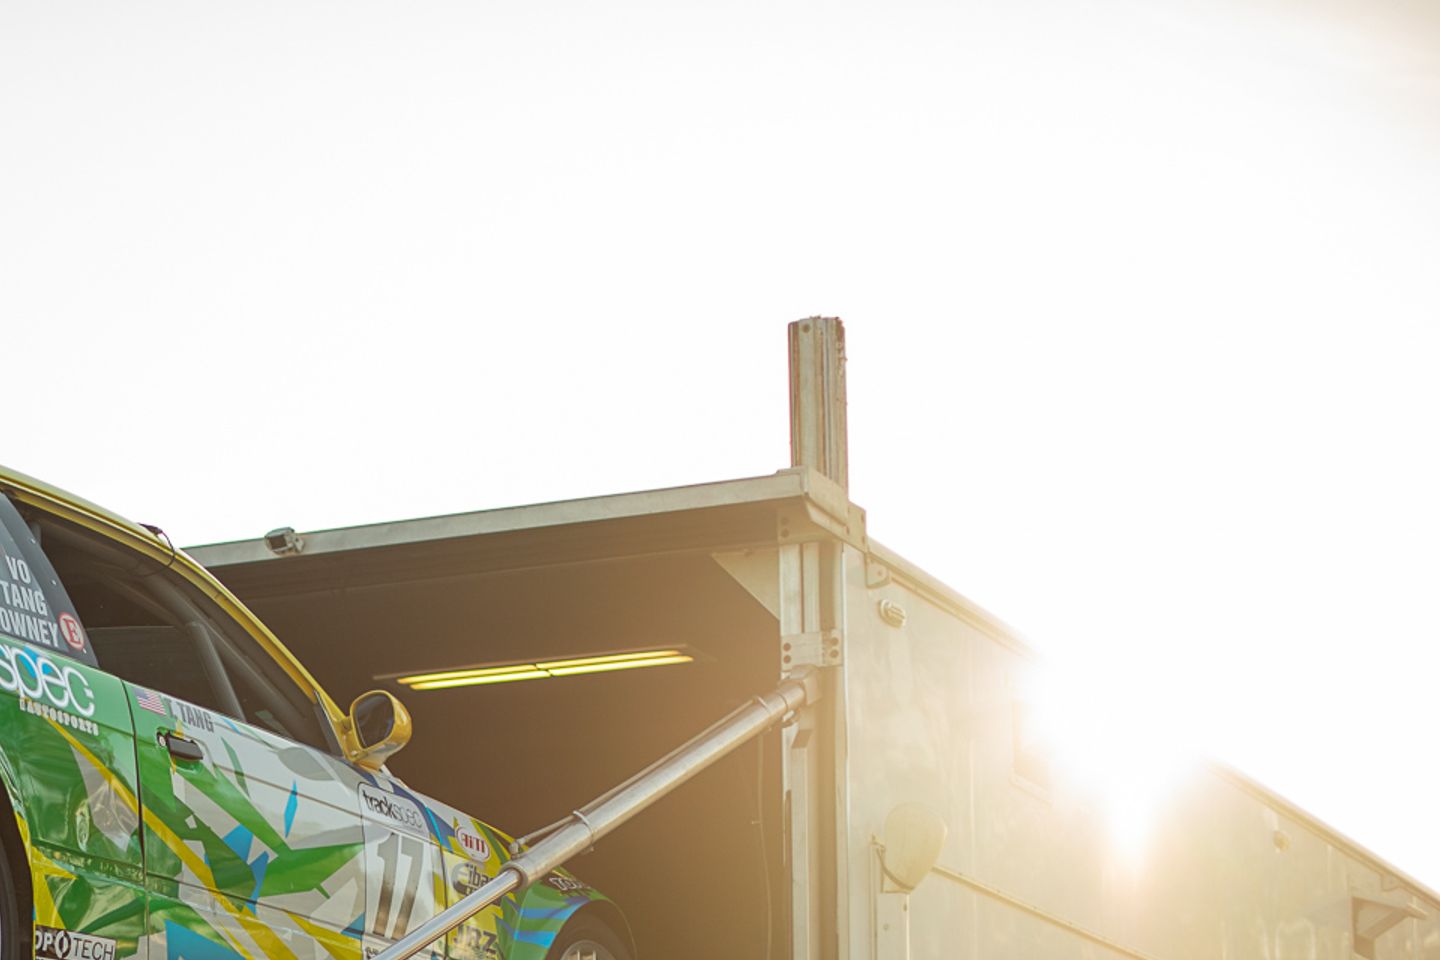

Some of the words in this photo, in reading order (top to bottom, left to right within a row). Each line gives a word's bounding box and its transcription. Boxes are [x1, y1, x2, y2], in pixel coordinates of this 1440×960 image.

[5, 554, 31, 584] VO
[0, 579, 48, 616] TANG
[176, 701, 215, 733] TANG
[373, 832, 424, 941] 17
